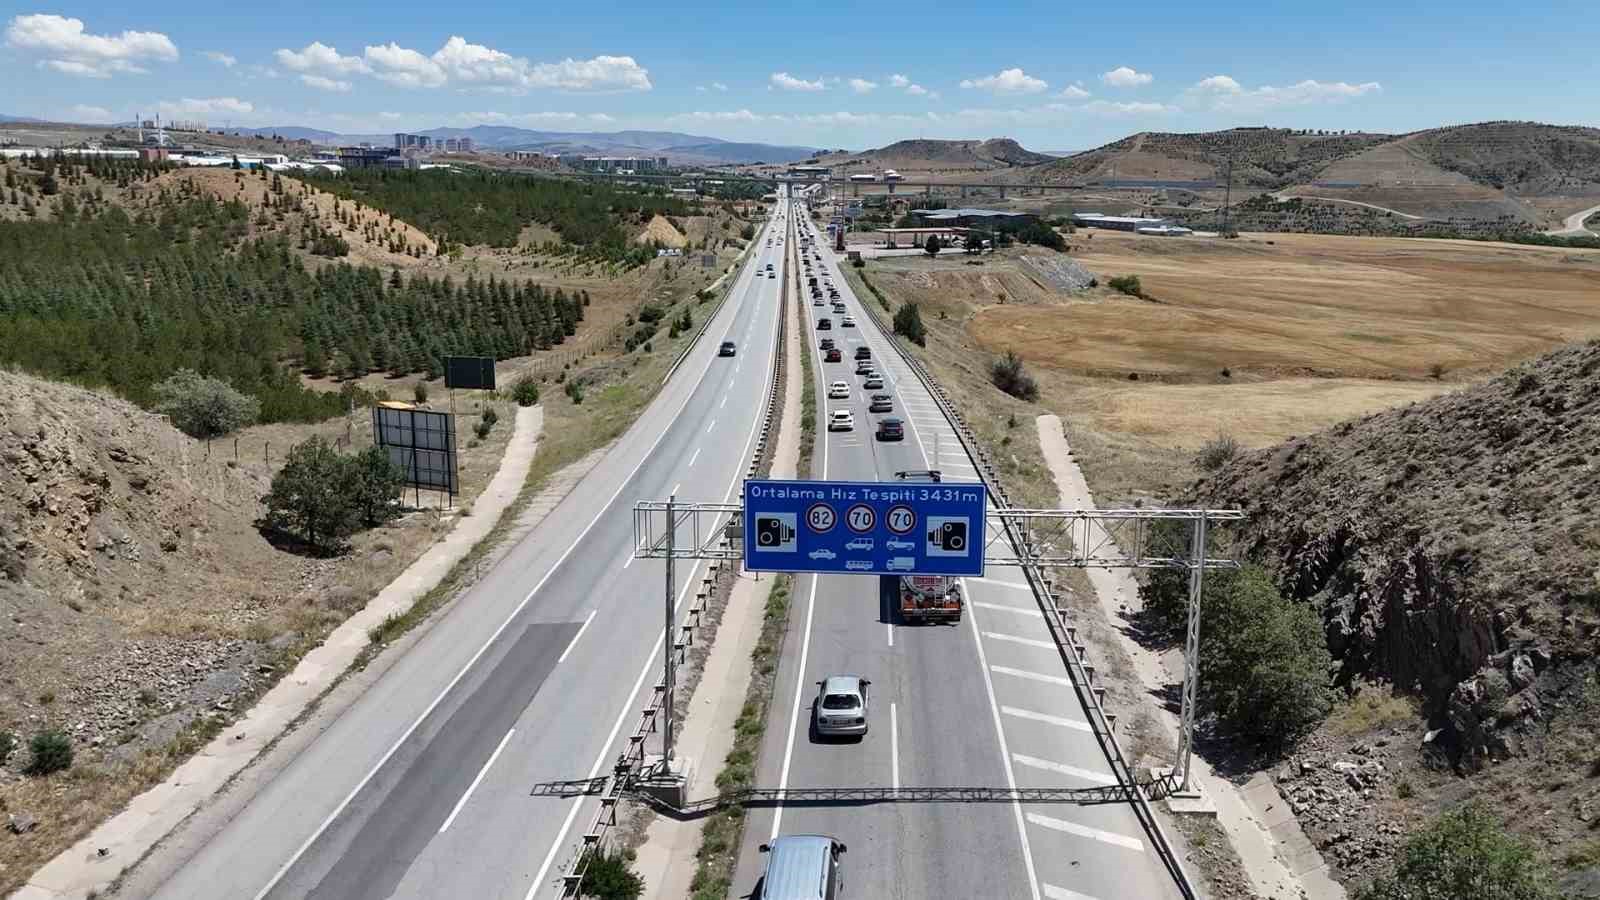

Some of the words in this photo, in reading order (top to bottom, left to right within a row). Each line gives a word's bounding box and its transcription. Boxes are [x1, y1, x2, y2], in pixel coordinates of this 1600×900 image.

[751, 486, 825, 500] Ortalama
[831, 488, 857, 500] Hız
[862, 488, 915, 502] Tespiti
[920, 489, 978, 502] 3431m
[812, 511, 830, 525] 82
[853, 512, 870, 526] 70
[893, 512, 911, 527] 70
